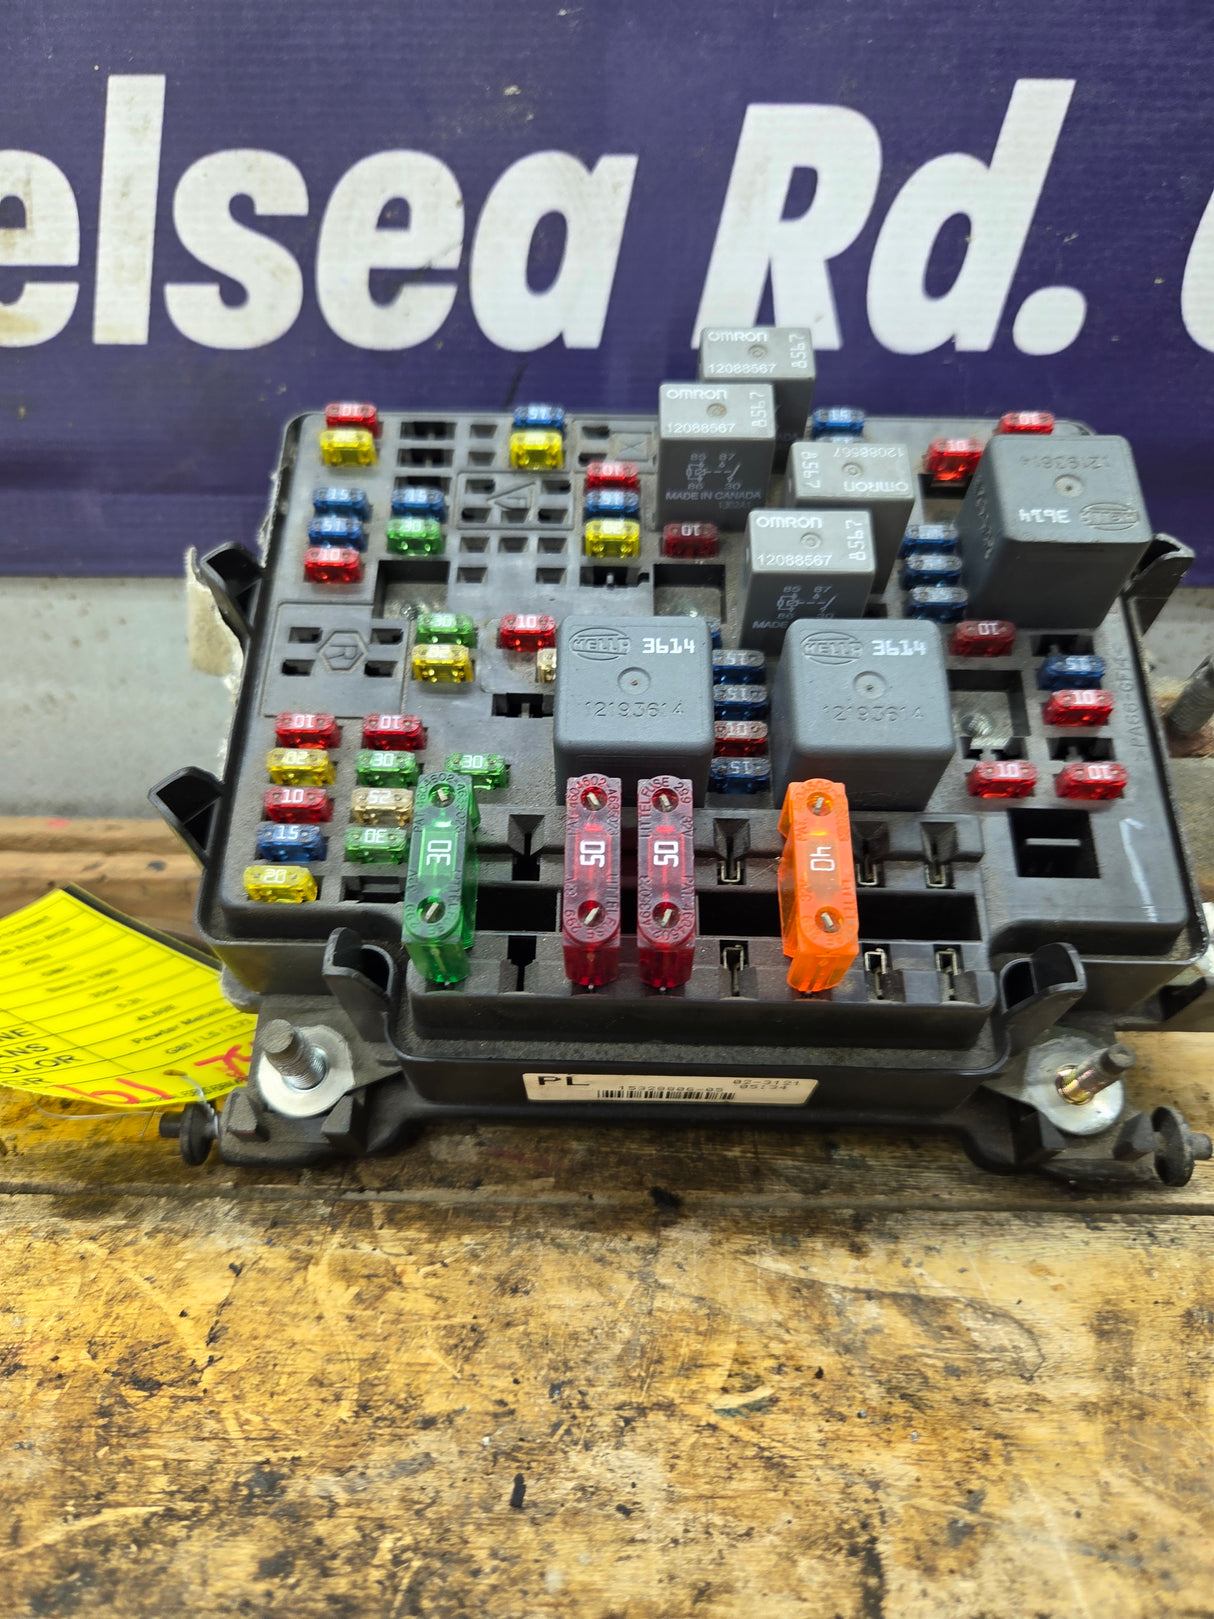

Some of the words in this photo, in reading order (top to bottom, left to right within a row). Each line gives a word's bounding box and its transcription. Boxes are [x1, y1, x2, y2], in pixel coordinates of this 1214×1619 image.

[691, 79, 1087, 355] Rd.
[788, 333, 808, 369] 8567
[707, 362, 777, 374] 12088567
[748, 390, 768, 428] 8567
[666, 422, 736, 434] 12088567
[665, 490, 699, 501] MADE
[700, 490, 713, 501] IN
[714, 490, 761, 501] CANADA
[844, 519, 866, 561] 8567
[757, 554, 833, 567] 12088567
[641, 637, 696, 654] 3614
[871, 639, 927, 656] 3614
[371, 753, 395, 767] 30
[463, 755, 484, 768] 30
[281, 788, 305, 803] 10
[274, 825, 299, 840] 15
[425, 839, 453, 866] 30
[579, 840, 605, 868] 50
[653, 840, 680, 868] 50
[809, 845, 836, 872] 40
[262, 868, 287, 884] 20
[538, 1076, 590, 1086] PL
